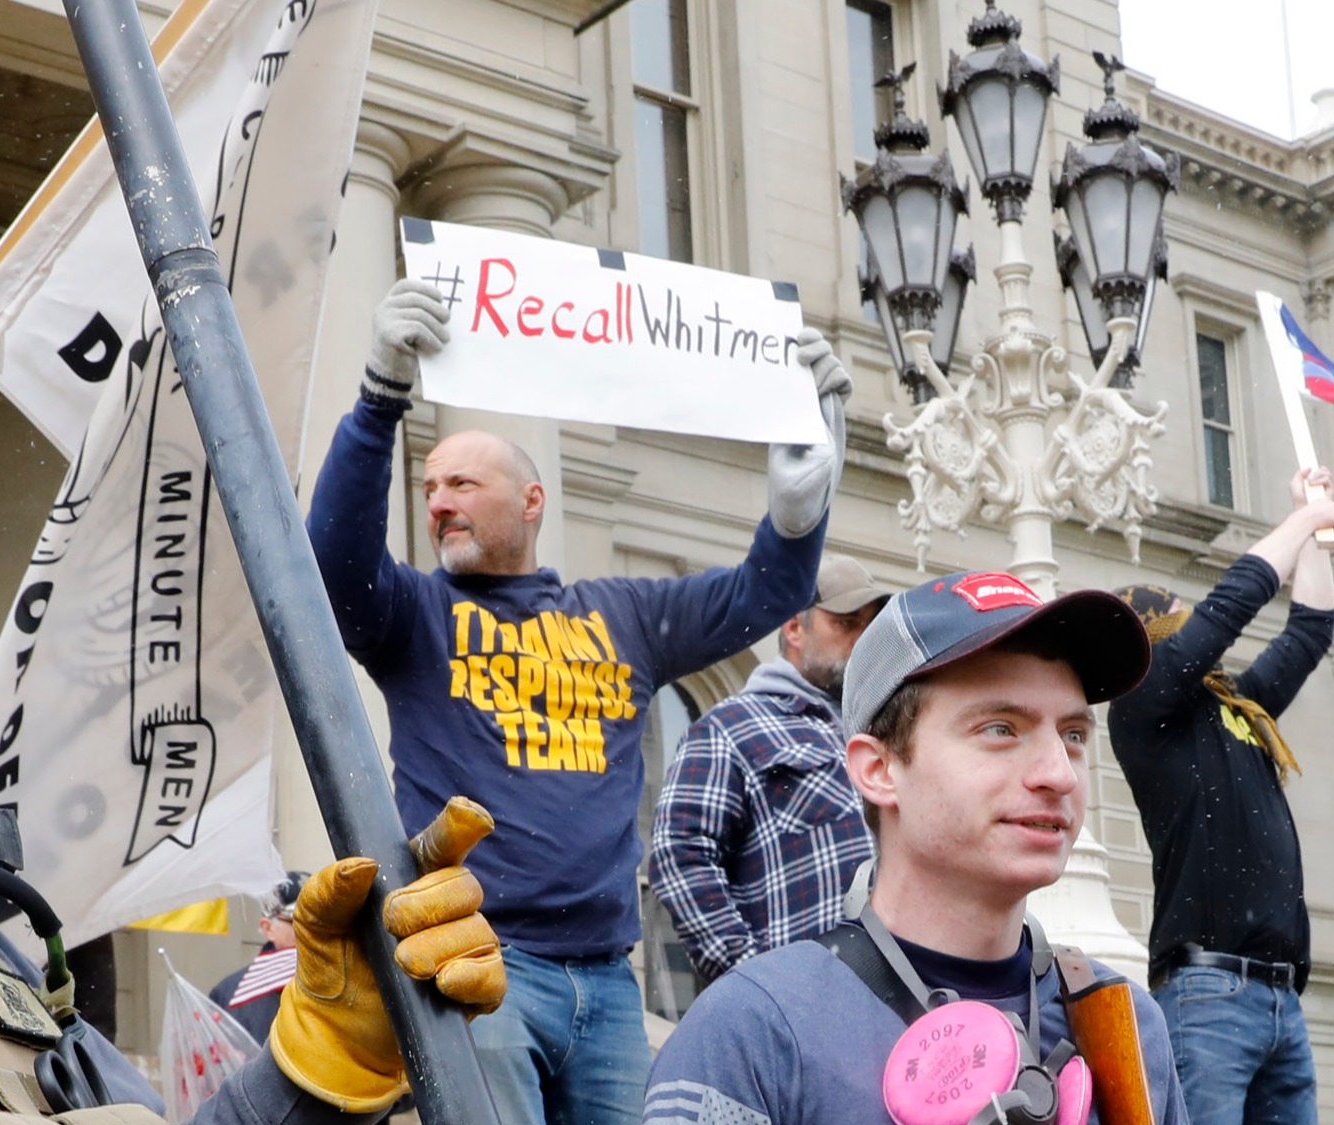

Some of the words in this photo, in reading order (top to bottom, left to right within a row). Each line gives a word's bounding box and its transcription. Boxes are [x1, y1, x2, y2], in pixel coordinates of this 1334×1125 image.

[149, 471, 192, 664] MINUTE
[452, 600, 618, 662] TYRANNY
[449, 654, 637, 721] RESPONSE
[495, 711, 607, 774] TEAM
[155, 741, 198, 827] MEN
[919, 1024, 966, 1051] 2097
[972, 1043, 987, 1069] 3M
[905, 1058, 920, 1083] 3M
[925, 1078, 974, 1105] 2097
